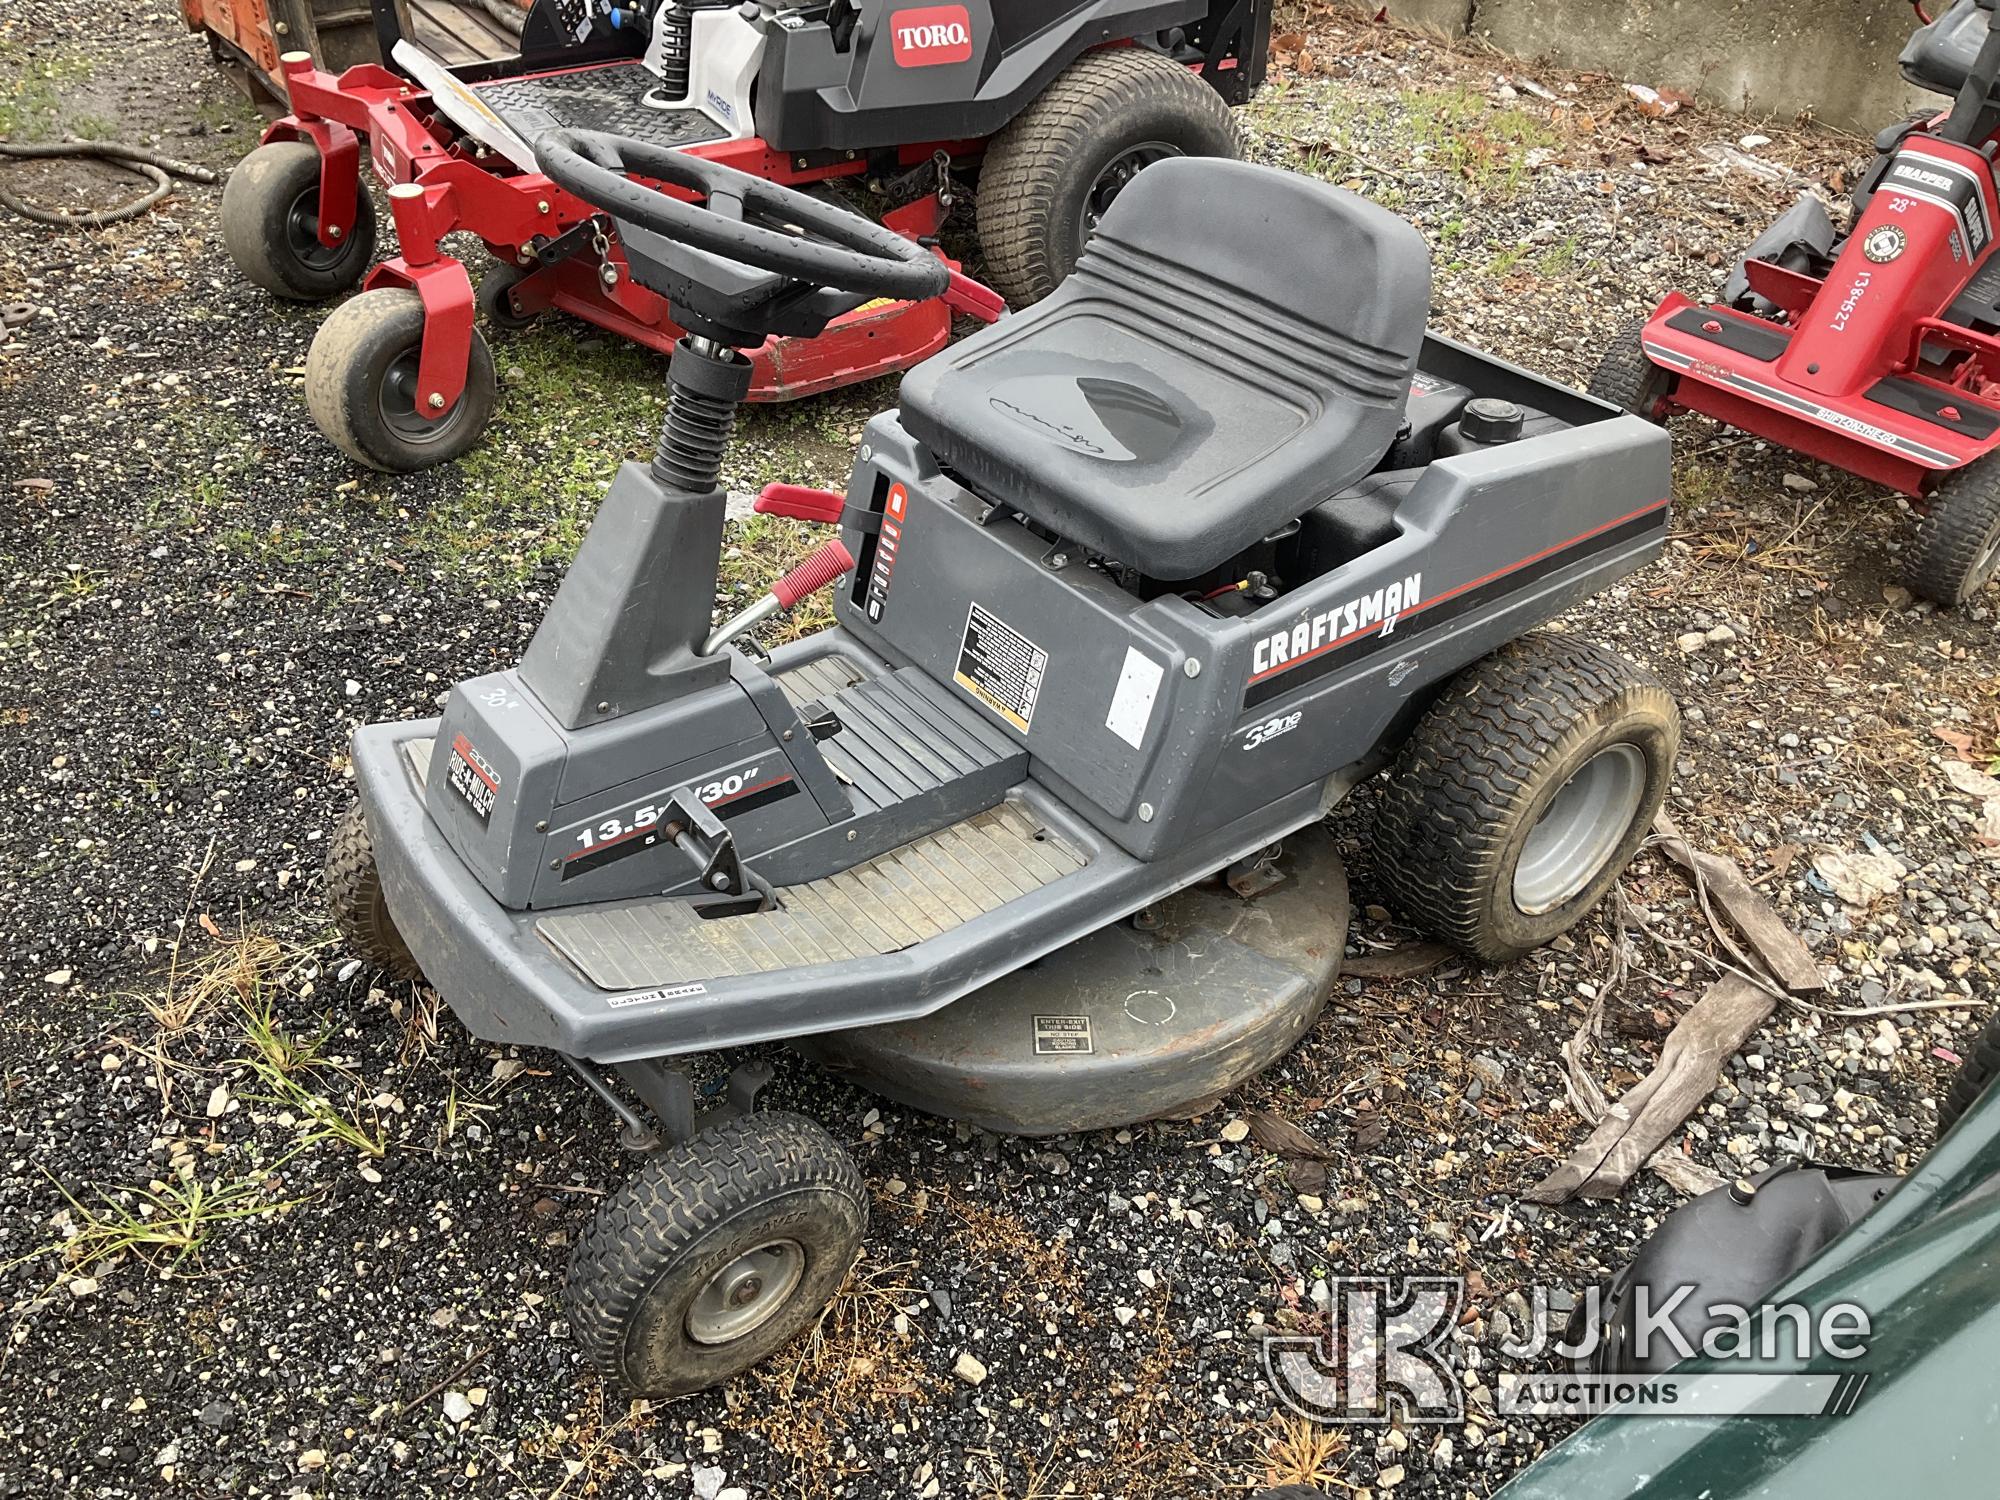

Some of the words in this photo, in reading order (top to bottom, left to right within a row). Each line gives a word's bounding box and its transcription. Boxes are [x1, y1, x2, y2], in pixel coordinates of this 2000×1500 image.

[1893, 165, 1954, 192] SNAPPER
[1830, 272, 1872, 331] 1384527
[1816, 408, 1897, 445] SHIFT-ON-THE-GO
[1253, 573, 1421, 675] CRAFTSMAN
[975, 687, 1002, 709] WARNING
[449, 751, 496, 813] RIDE-N-MULCH
[468, 749, 501, 785] 2000
[451, 773, 467, 794] Made
[472, 796, 486, 818] USA
[611, 994, 657, 1005] CLUTCH
[667, 986, 703, 996] BRAKE
